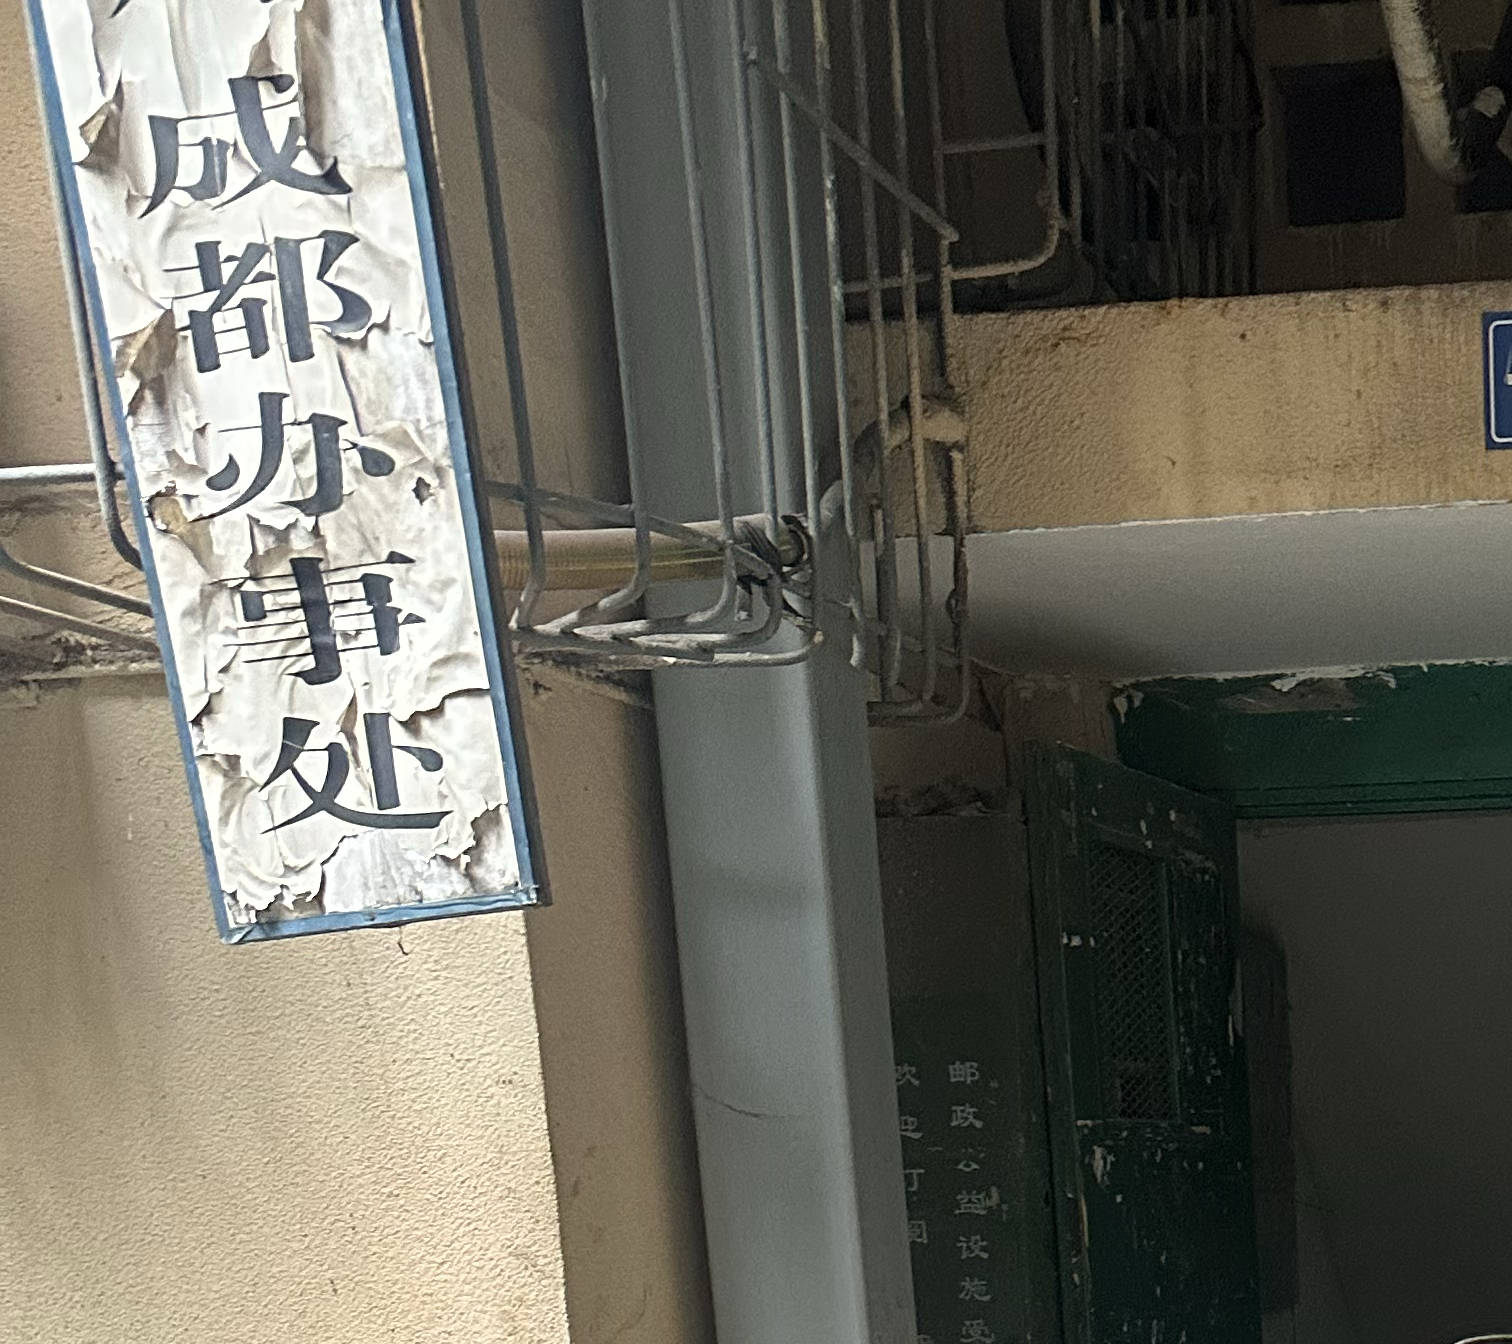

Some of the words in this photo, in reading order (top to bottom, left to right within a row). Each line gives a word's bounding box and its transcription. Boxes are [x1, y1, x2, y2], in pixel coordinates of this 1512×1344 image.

[109, 0, 453, 835] 成都办事处
